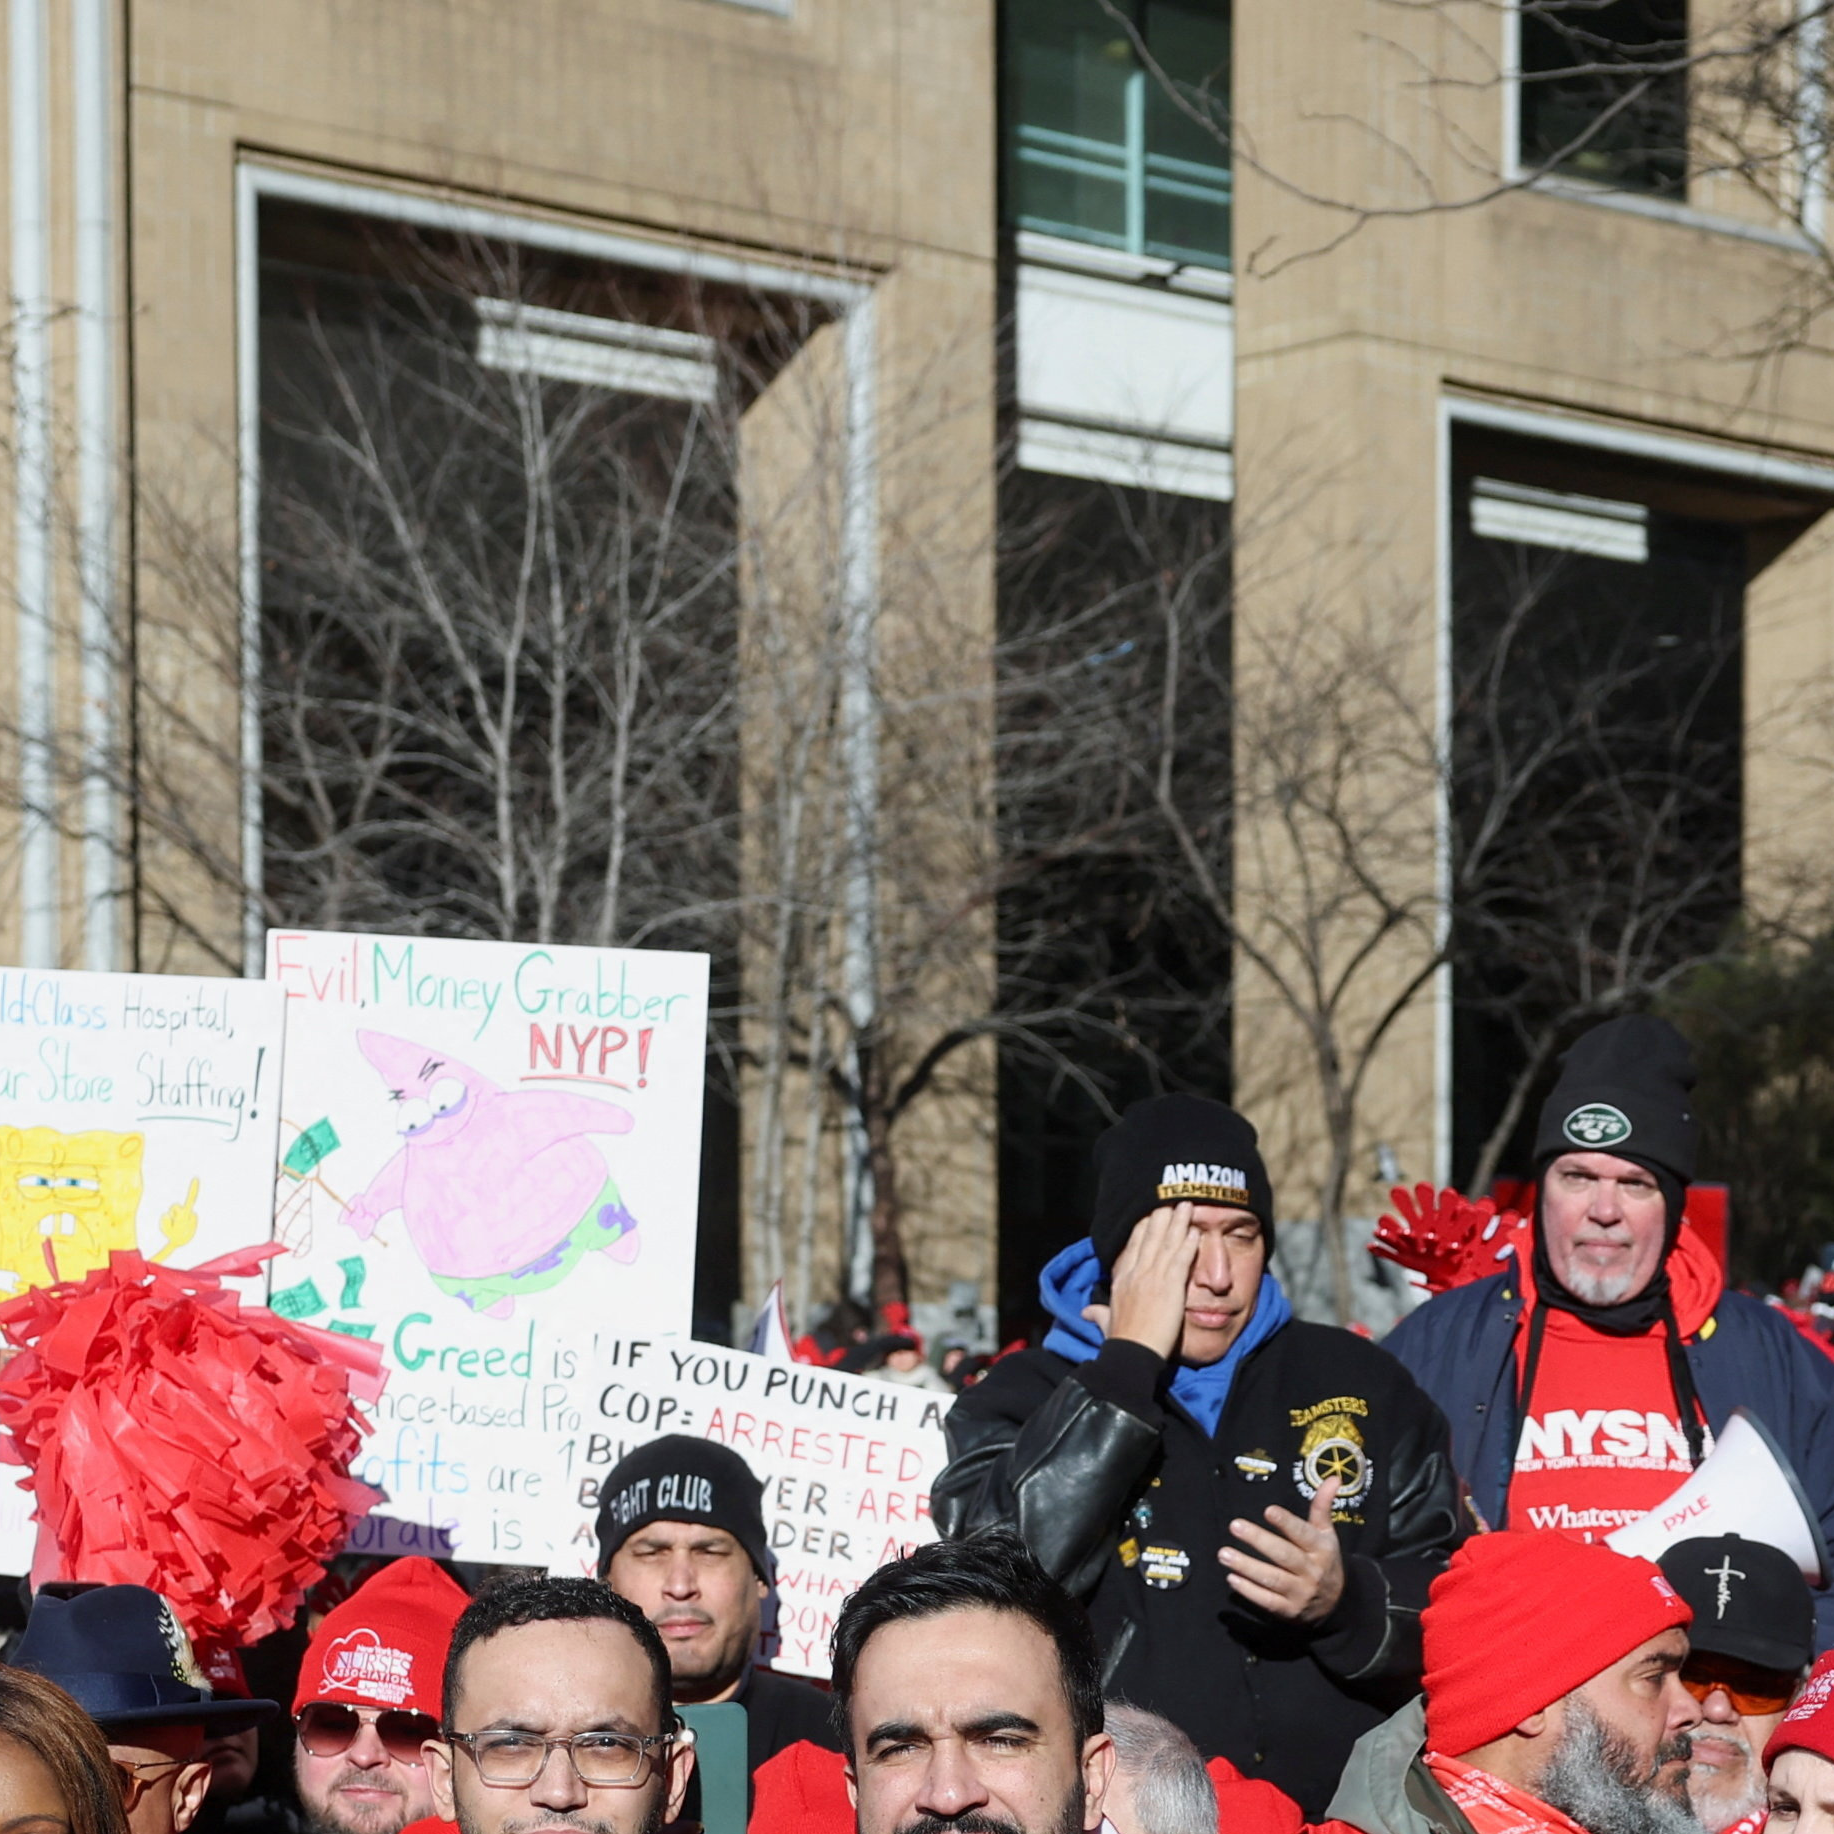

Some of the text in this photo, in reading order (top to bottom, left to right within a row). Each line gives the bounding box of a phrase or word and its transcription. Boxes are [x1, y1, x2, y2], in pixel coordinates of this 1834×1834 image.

[123, 984, 235, 1039] Hospital,
[372, 942, 503, 1042] Money
[514, 950, 691, 1024] Grabber
[37, 1035, 114, 1104] Store
[528, 1023, 654, 1089] NYP!
[1161, 1162, 1247, 1190] AMAZON
[393, 1311, 579, 1380] Greed is
[611, 1340, 652, 1368] IF
[670, 1349, 749, 1392] YOU
[764, 1367, 899, 1422] PUNCH
[704, 1406, 924, 1483] ARRESTED
[1546, 1456, 1580, 1471] YORK
[1580, 1454, 1616, 1469] STATE
[1618, 1455, 1667, 1472] NURSES
[487, 1464, 543, 1498] are
[657, 1473, 713, 1514] CLUB
[493, 1507, 523, 1551] is
[330, 1668, 413, 1687] ASSOCIATION
[336, 1650, 412, 1677] NURSES
